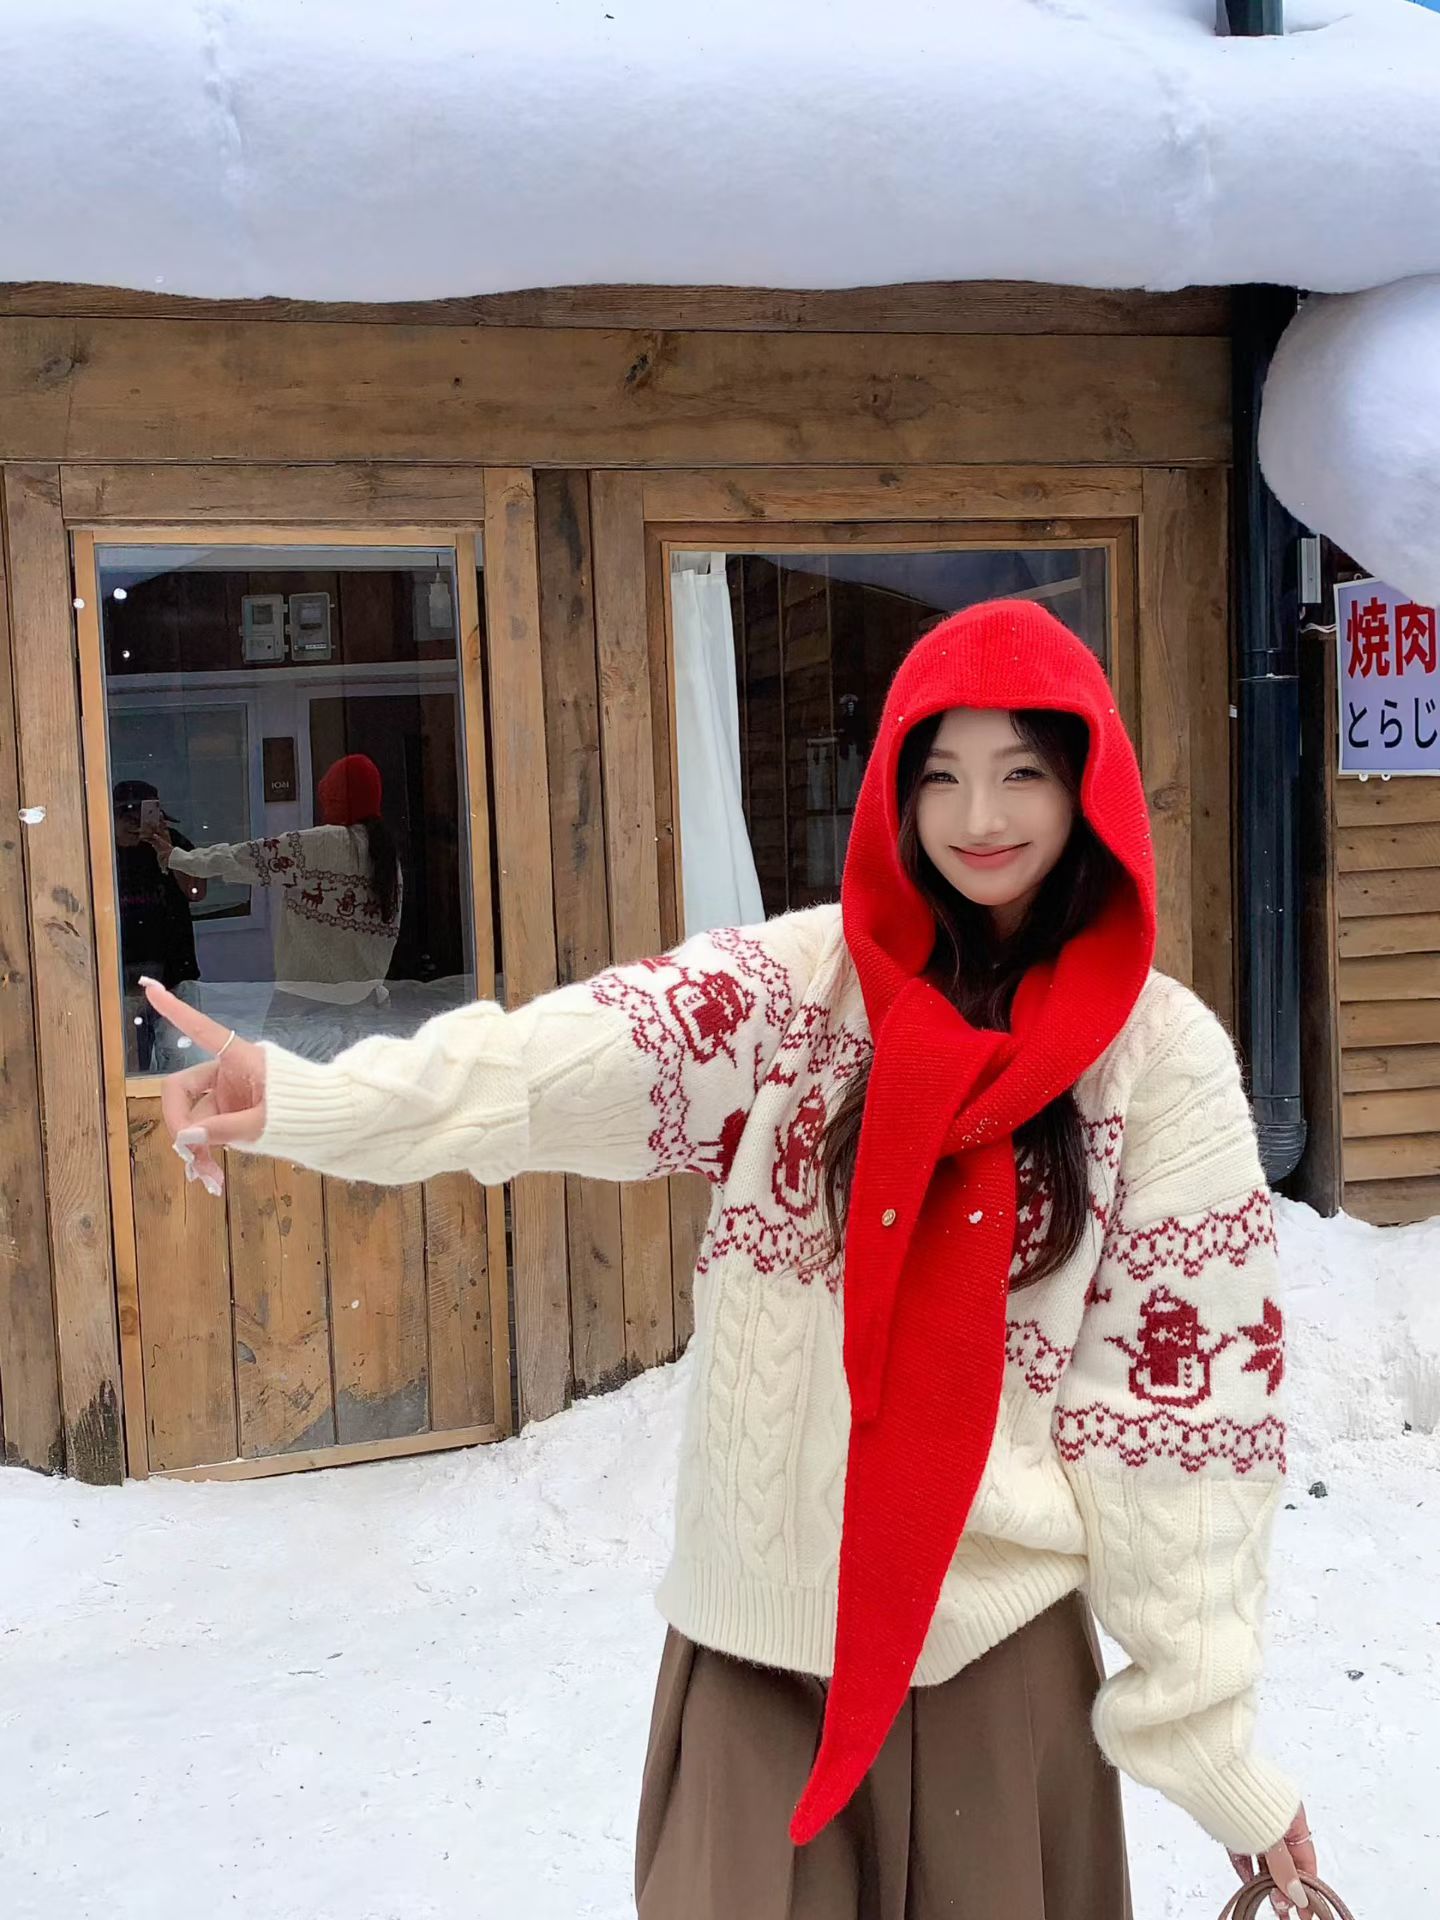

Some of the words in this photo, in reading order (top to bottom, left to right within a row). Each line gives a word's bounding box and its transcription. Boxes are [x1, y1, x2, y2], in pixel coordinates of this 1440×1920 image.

[1347, 597, 1437, 678] 焼肉
[1348, 697, 1438, 749] とらじ
